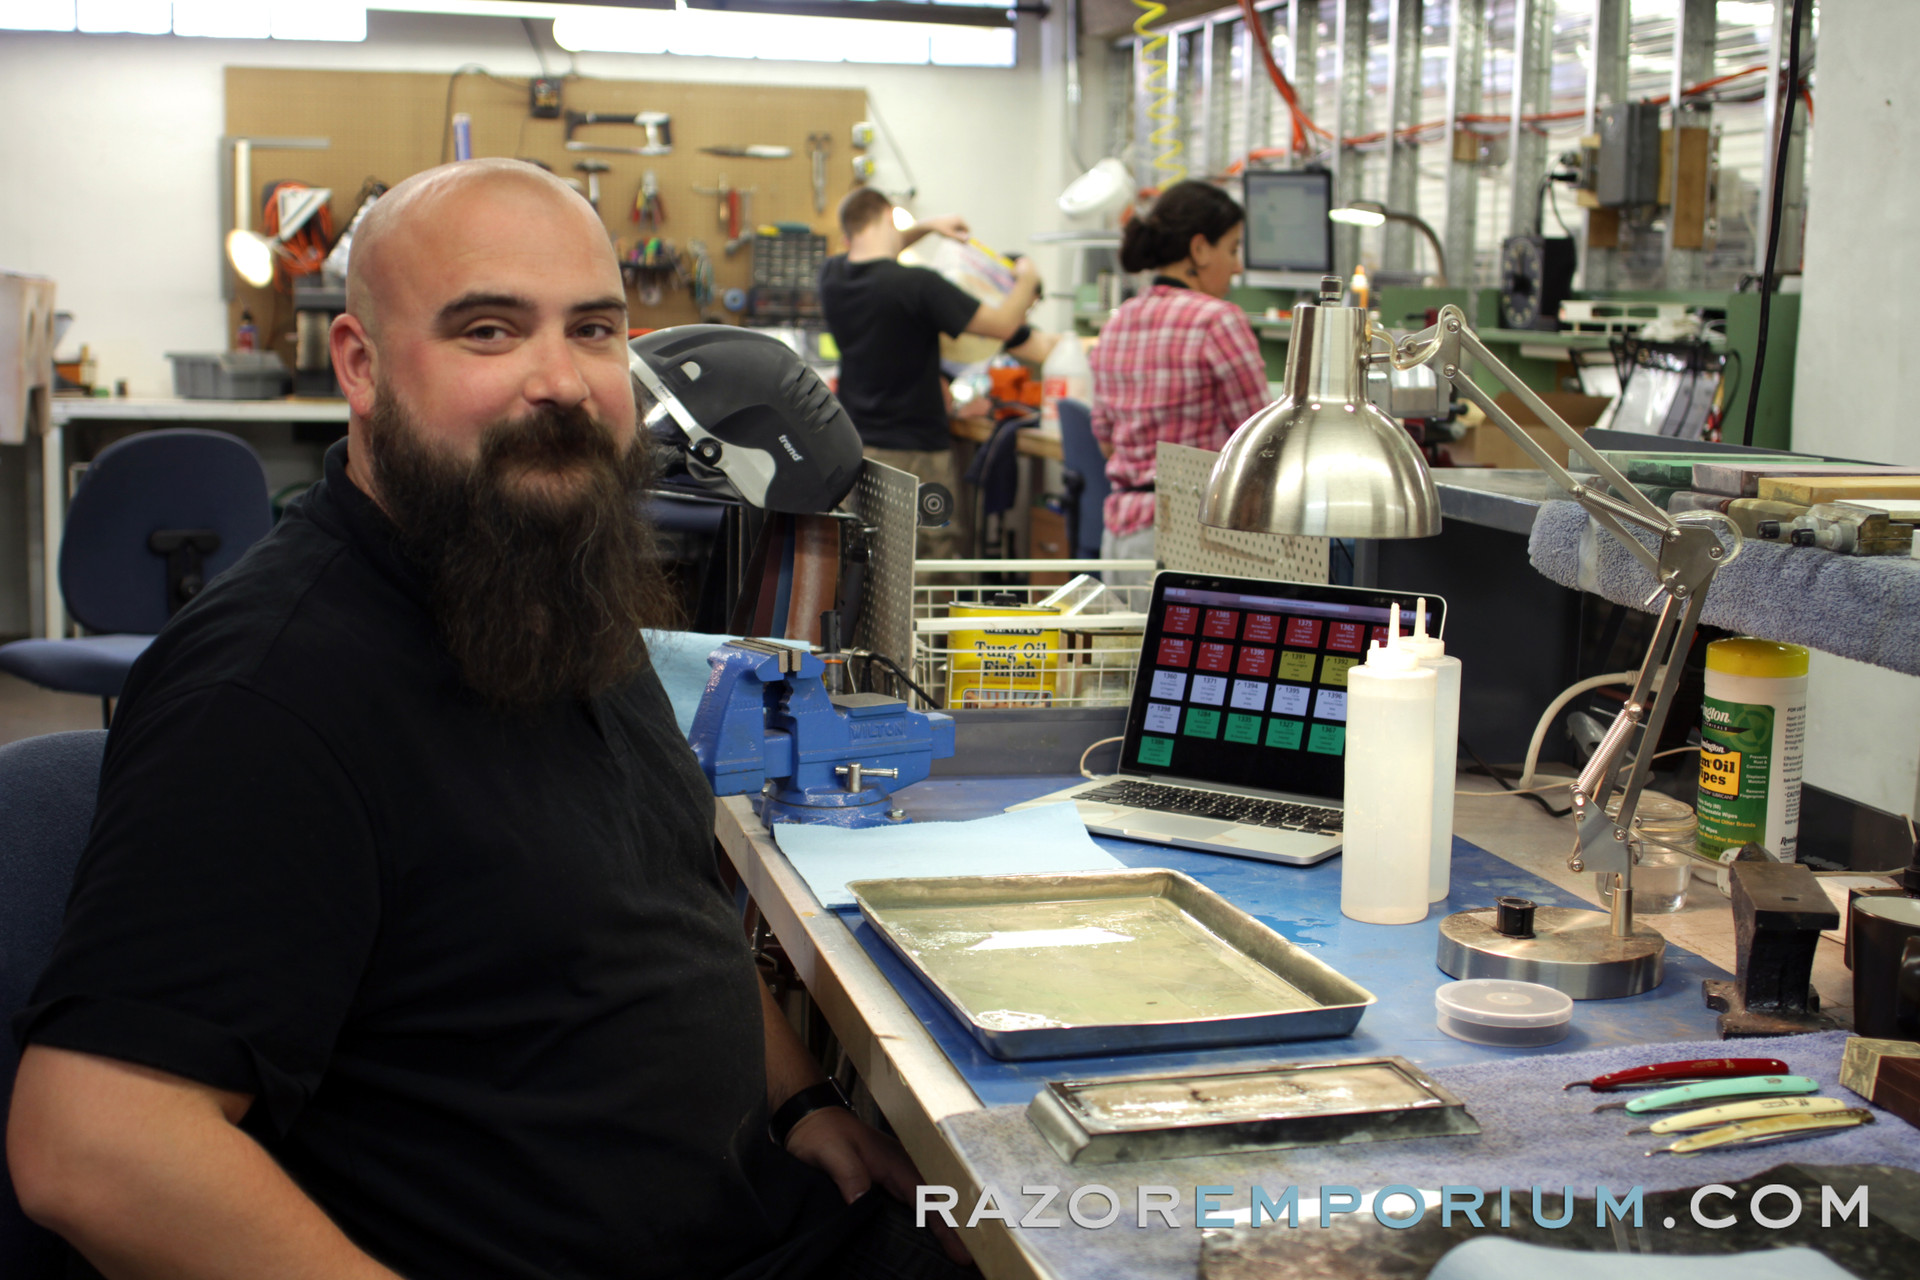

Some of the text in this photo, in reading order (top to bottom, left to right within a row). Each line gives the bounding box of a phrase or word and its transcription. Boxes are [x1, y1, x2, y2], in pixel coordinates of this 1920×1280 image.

[779, 434, 803, 461] trend
[975, 640, 1047, 664] Tung Oil
[1250, 648, 1265, 656] 1390
[983, 660, 1037, 678] Finish
[850, 720, 905, 739] WILTON
[1713, 758, 1735, 774] Oil
[1700, 766, 1726, 785] ipes
[1722, 811, 1738, 819] Wipes
